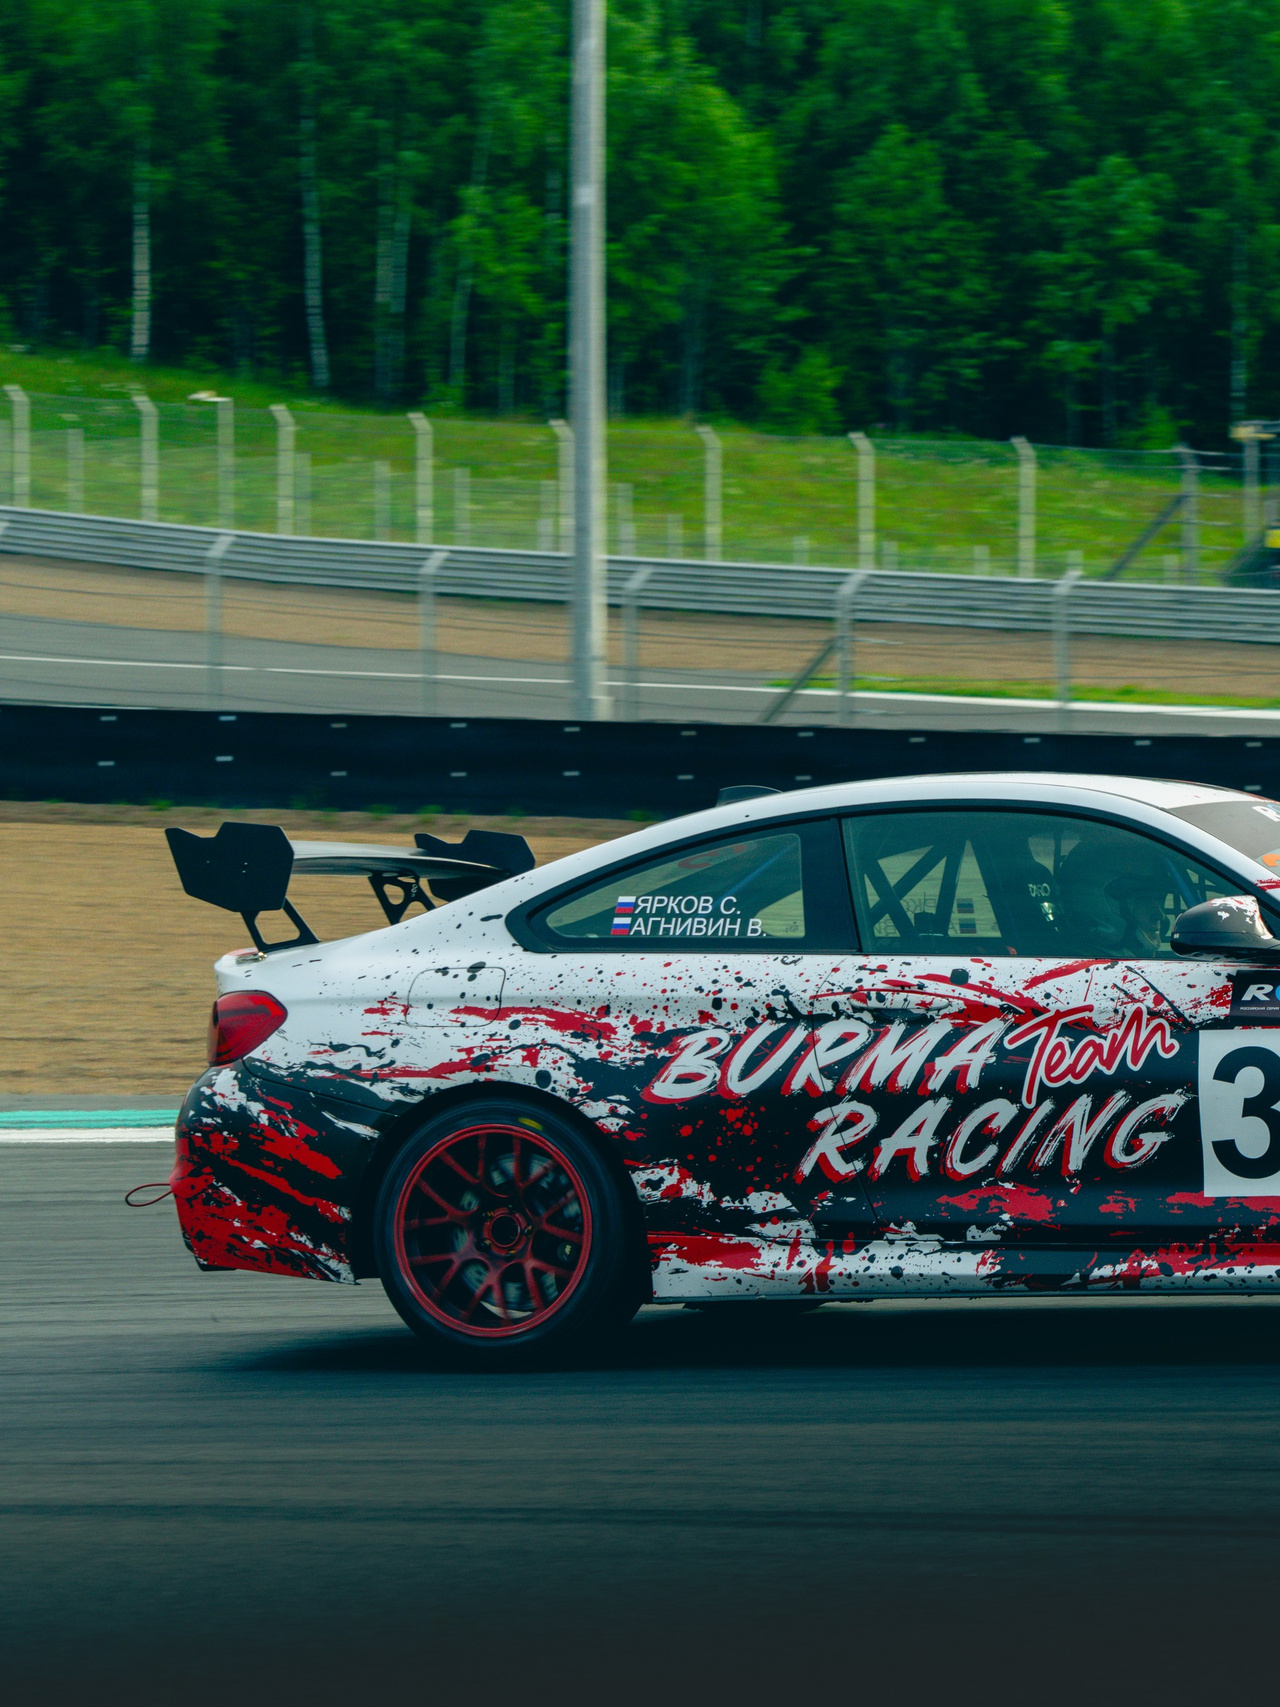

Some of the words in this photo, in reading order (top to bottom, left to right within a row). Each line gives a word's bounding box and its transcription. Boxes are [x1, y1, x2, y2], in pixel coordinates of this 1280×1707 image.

[629, 917, 742, 936] АГНИВИН
[747, 918, 767, 937] В.
[634, 896, 713, 914] ЯРКОВ
[720, 896, 741, 915] С.
[643, 1013, 1014, 1102] BURMA
[1003, 1003, 1179, 1109] Team
[796, 1089, 1194, 1183] RACING
